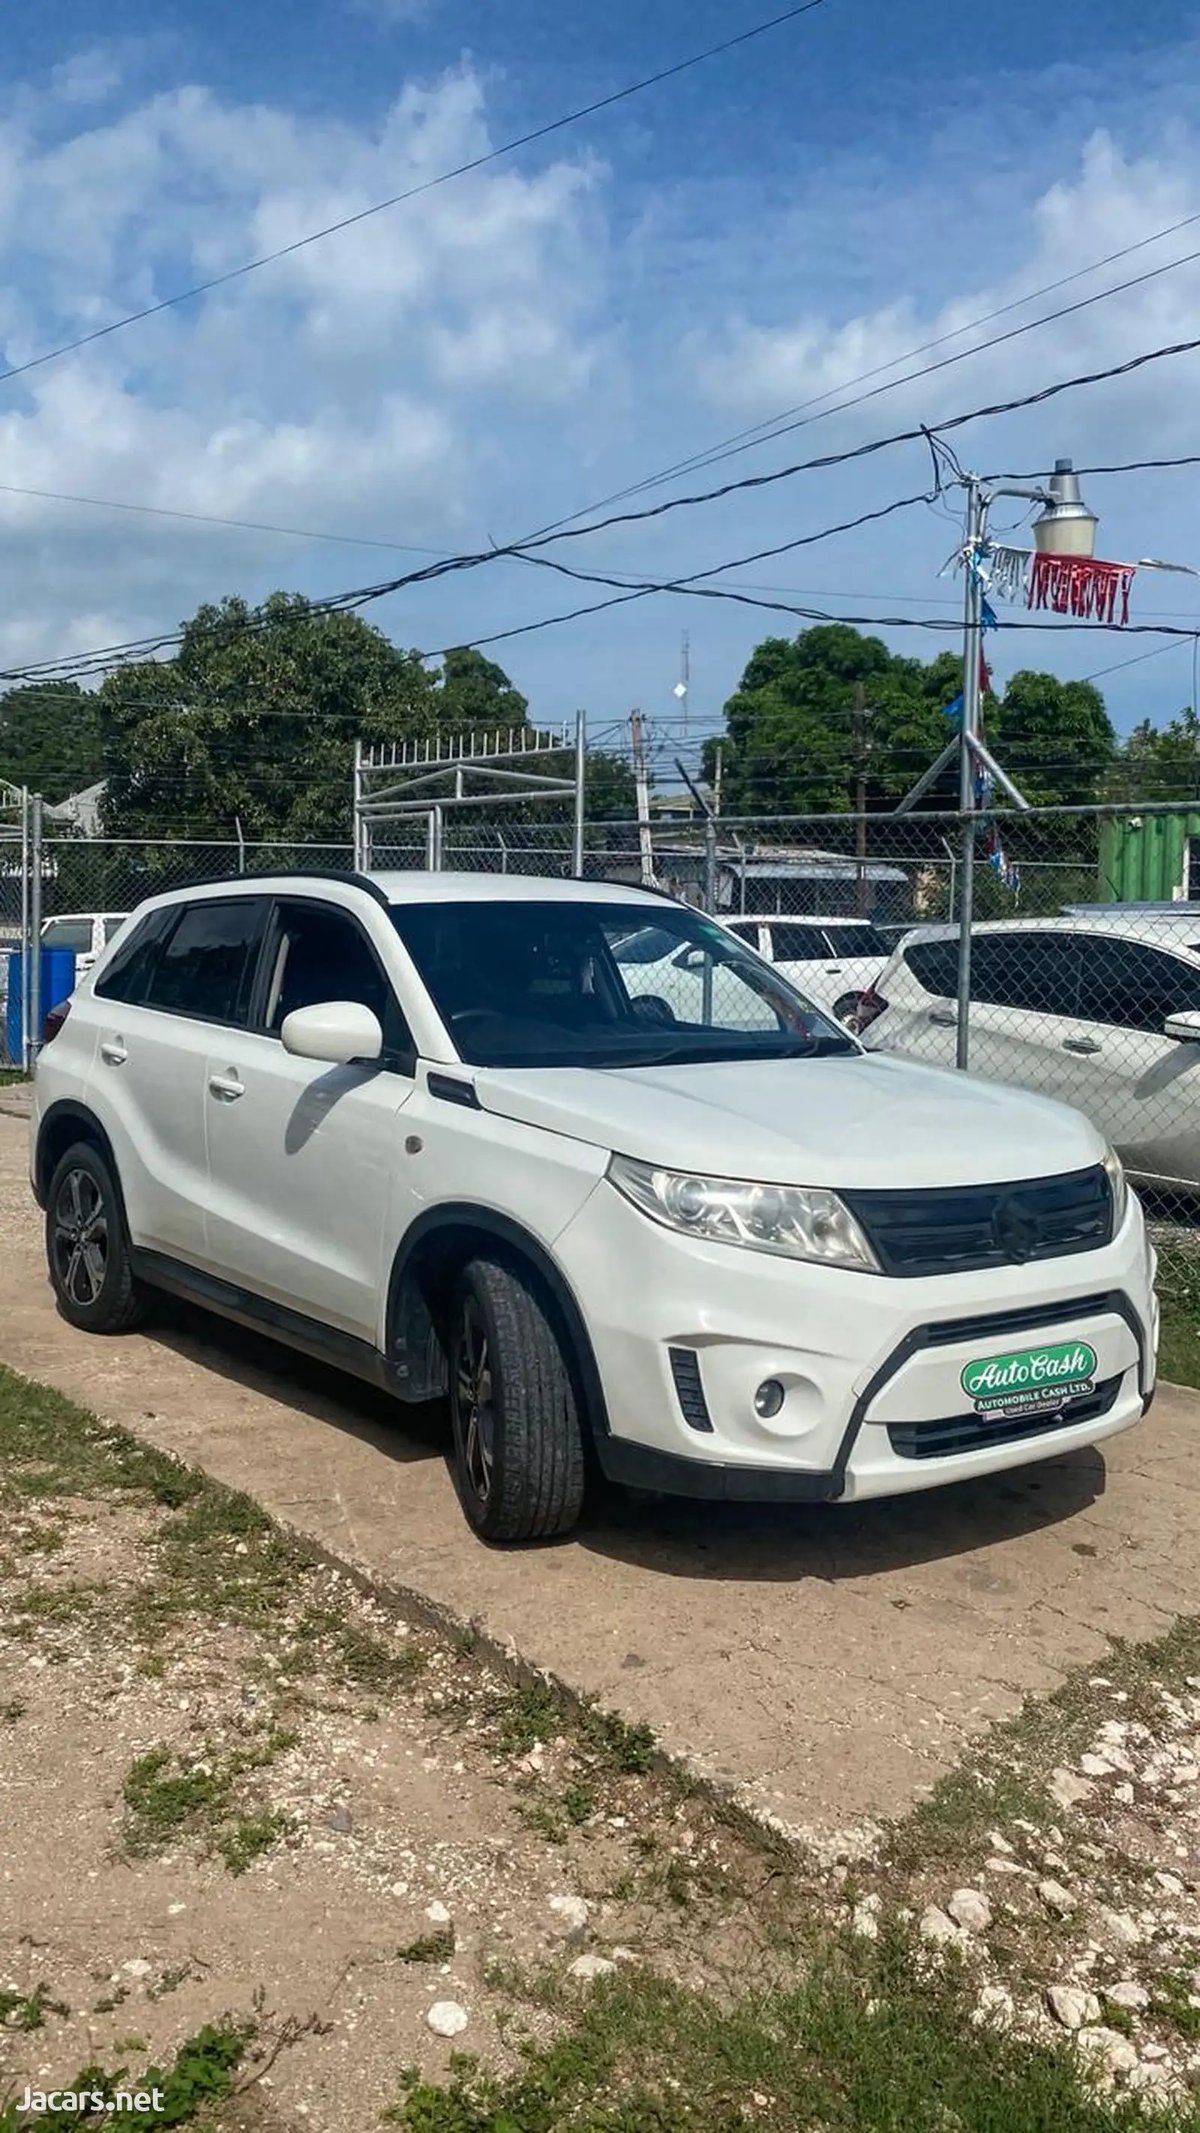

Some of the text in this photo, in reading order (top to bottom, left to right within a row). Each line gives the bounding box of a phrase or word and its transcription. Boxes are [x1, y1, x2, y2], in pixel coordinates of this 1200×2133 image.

[977, 1381, 1091, 1410] AUTOMOBILE CASH LTD.
